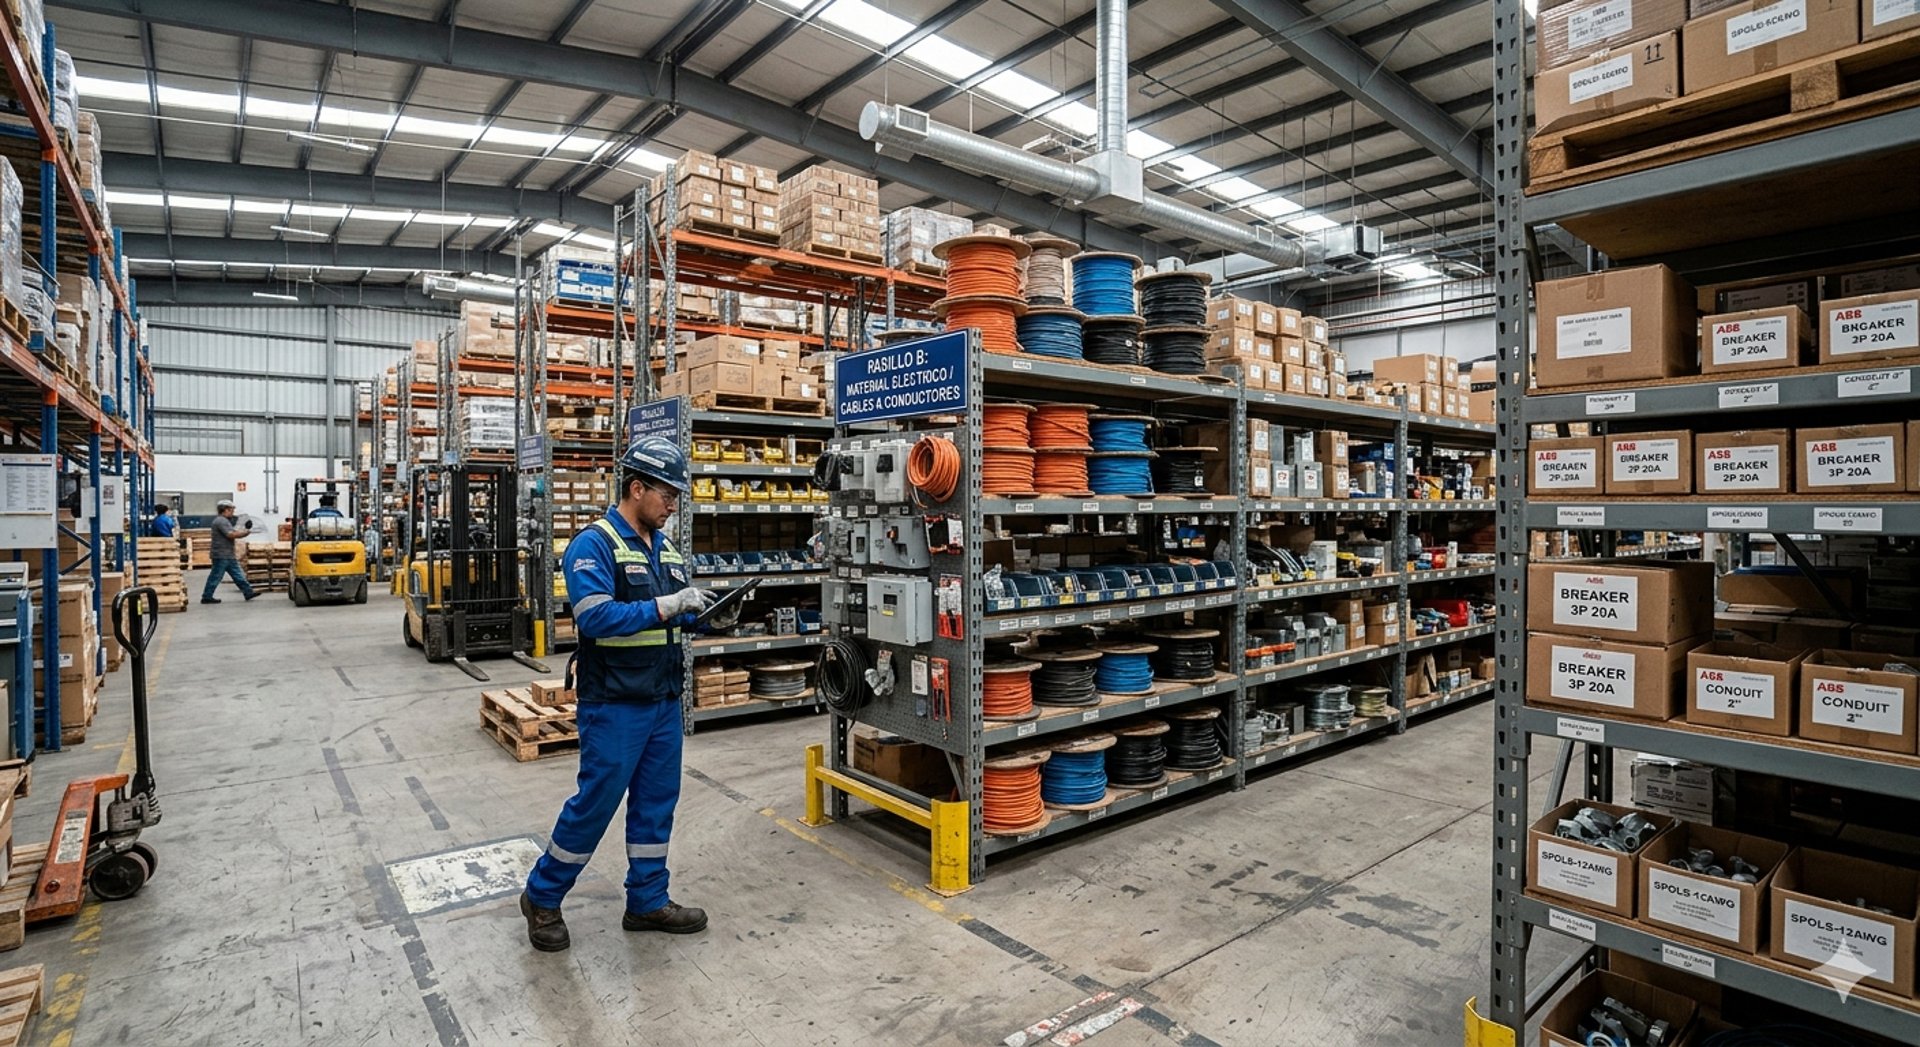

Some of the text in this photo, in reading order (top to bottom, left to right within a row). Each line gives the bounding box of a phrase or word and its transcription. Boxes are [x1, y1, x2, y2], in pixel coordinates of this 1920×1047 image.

[1835, 309, 1862, 321] ABB
[1852, 332, 1895, 344] 2P 20A
[1730, 347, 1745, 356] 3P
[868, 349, 928, 374] RASILLO B:
[846, 377, 890, 397] MATERIAL
[884, 385, 961, 409] CONDUCTORES
[1642, 464, 1661, 473] 20A
[1829, 467, 1871, 477] 3P 20A
[1723, 473, 1759, 482] 2P 20A
[1561, 588, 1629, 604] BREAKER
[1570, 604, 1618, 619] 3P 20A
[1558, 662, 1626, 681] BREAKER
[1568, 678, 1615, 695] 3P 20A
[1822, 696, 1890, 713] CONDUIT
